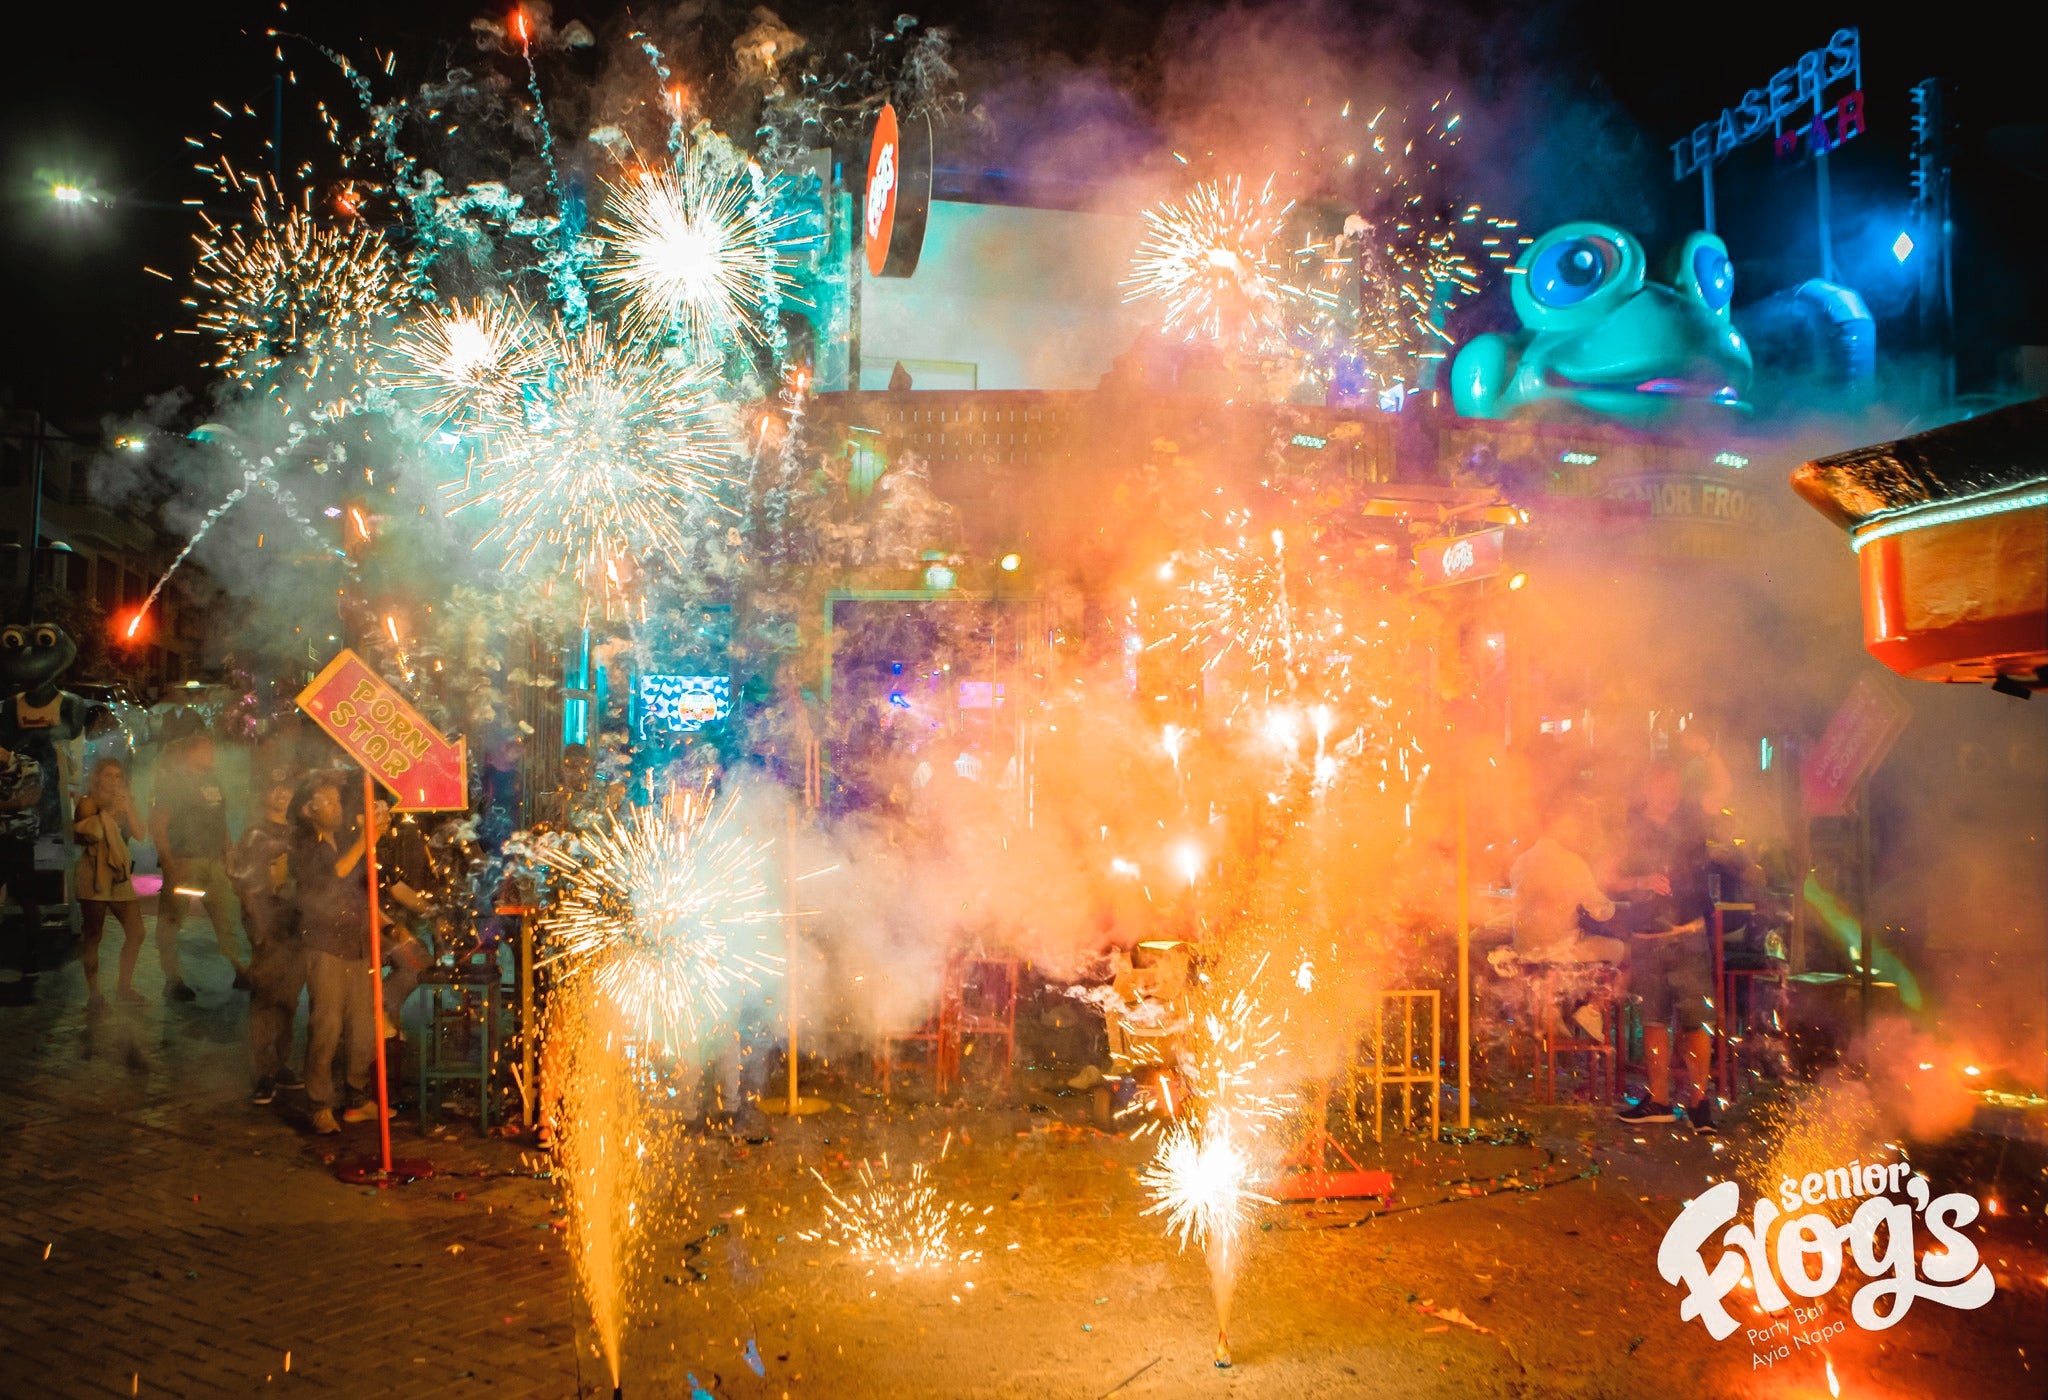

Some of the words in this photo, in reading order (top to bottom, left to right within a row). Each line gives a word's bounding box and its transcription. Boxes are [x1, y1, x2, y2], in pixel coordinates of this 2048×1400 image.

[1669, 27, 1857, 181] TEASERS
[330, 701, 411, 779] STAR
[351, 679, 432, 760] PORN
